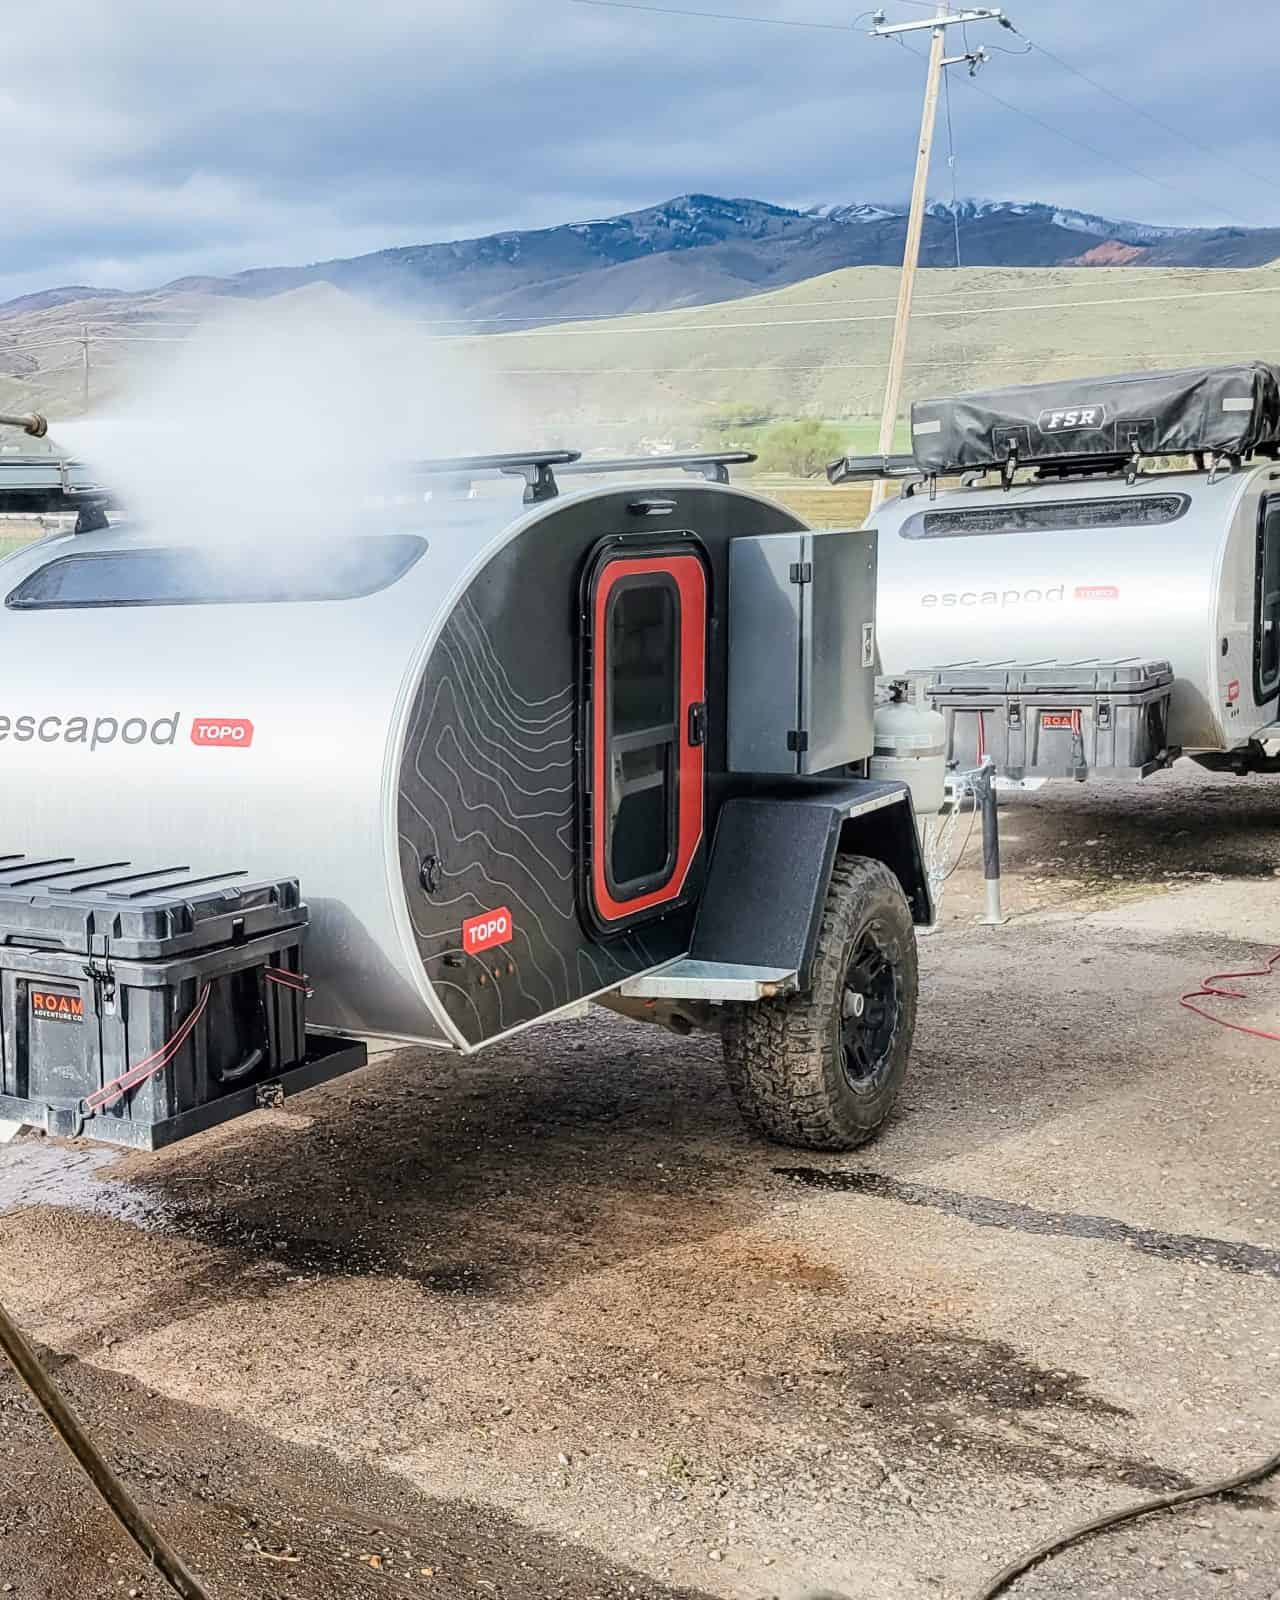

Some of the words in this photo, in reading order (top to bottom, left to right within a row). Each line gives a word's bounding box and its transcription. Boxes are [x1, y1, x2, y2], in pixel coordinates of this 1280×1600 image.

[1048, 410, 1095, 427] FSR
[921, 584, 1065, 608] escapod
[198, 725, 244, 740] TOPO
[469, 917, 506, 944] TOPO
[33, 993, 83, 1014] ROAM
[34, 1010, 72, 1019] ADVENTURE
